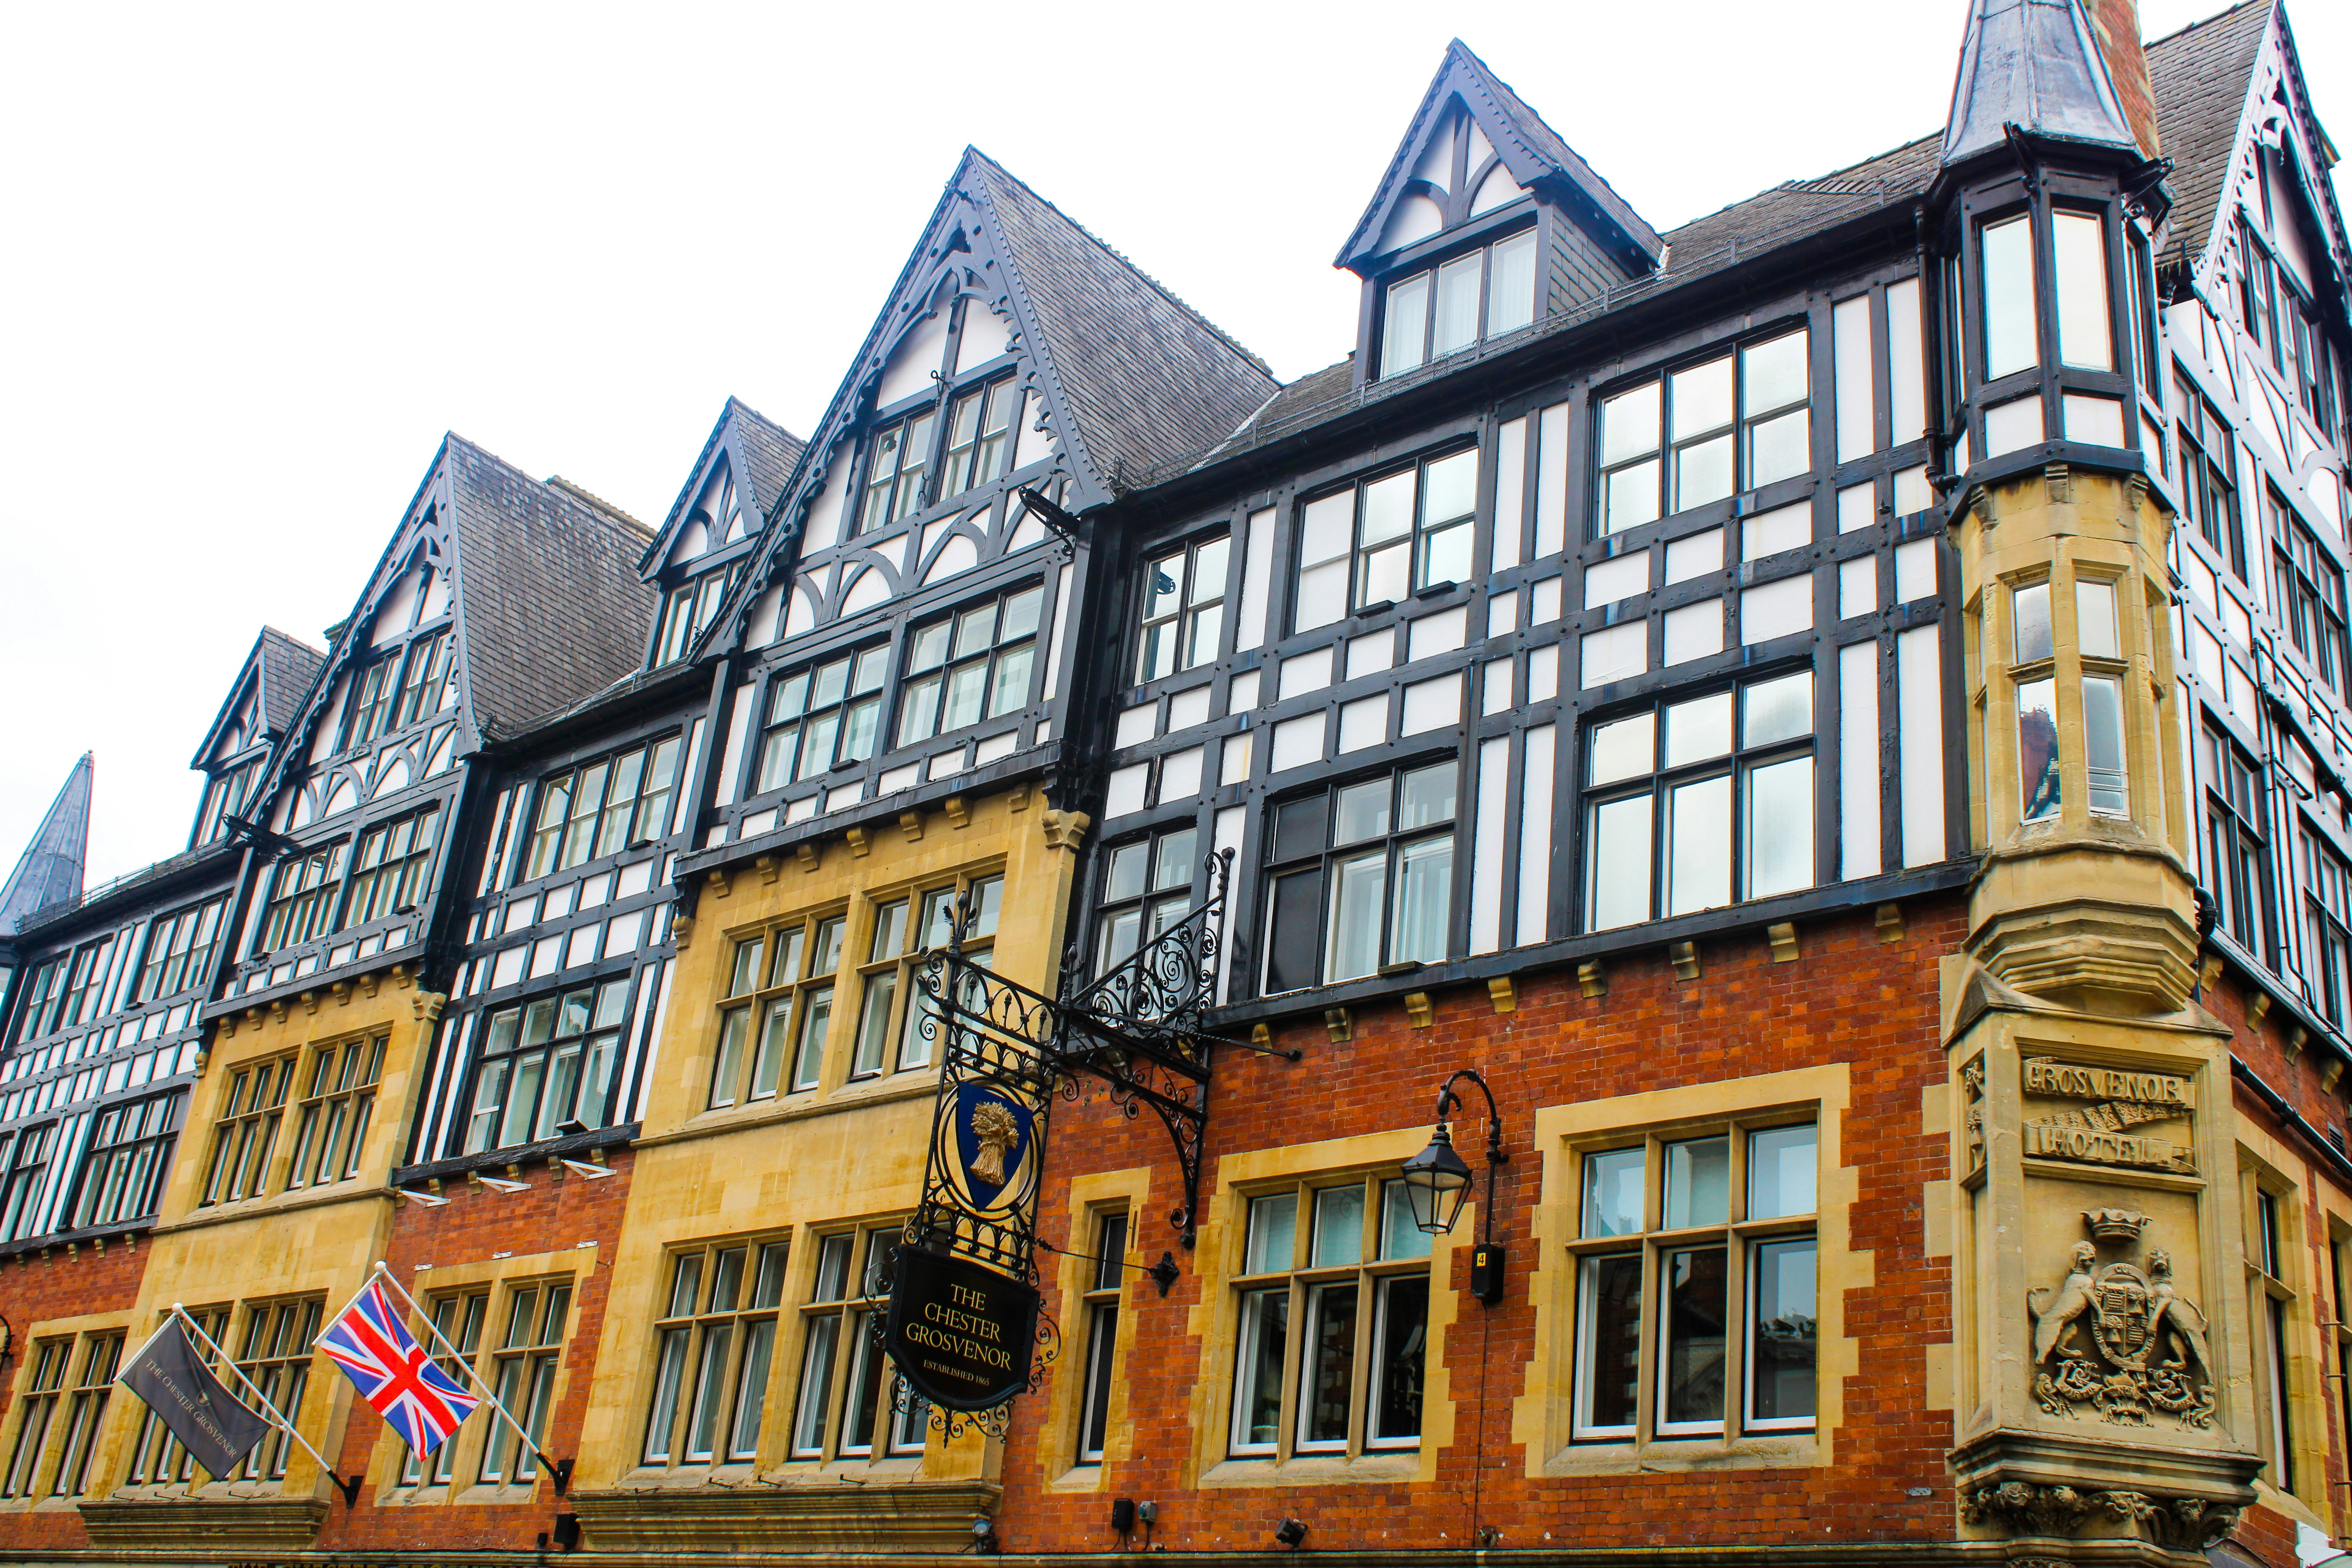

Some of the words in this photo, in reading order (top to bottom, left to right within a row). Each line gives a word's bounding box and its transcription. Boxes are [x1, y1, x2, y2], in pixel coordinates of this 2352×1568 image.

[2027, 1066, 2182, 1101] GROSVENOR
[2049, 1129, 2161, 1162] HOTEL
[1479, 1254, 1484, 1264] 4
[951, 1284, 986, 1310] THE
[925, 1303, 1000, 1342] CHESTER
[906, 1323, 1011, 1371] GROSVENOR
[924, 1359, 974, 1381] ESTABLISHED
[975, 1375, 989, 1386] 1865
[145, 1358, 165, 1379] THE
[163, 1376, 195, 1414] CHESTER
[193, 1411, 237, 1458] GROSVENOR
